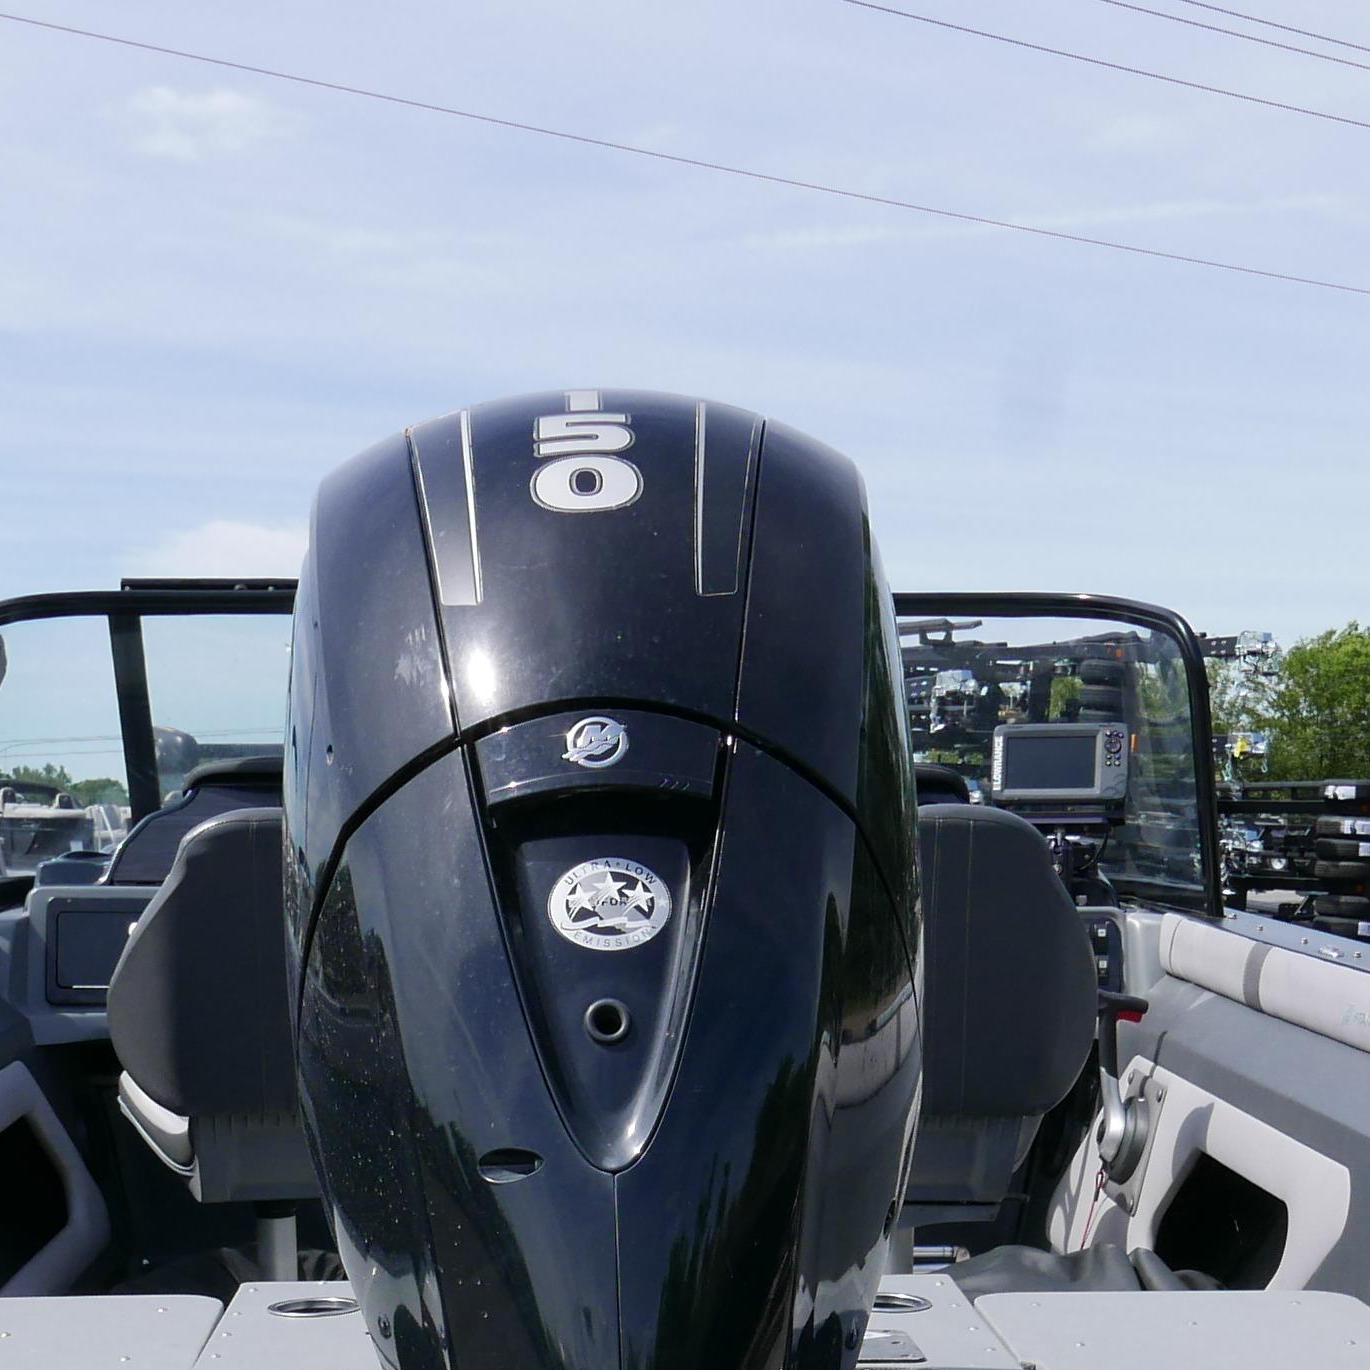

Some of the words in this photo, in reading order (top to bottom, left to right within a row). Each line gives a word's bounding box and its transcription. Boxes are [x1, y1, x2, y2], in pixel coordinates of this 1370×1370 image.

[530, 390, 644, 513] 150
[565, 860, 611, 885] ULTRA
[625, 863, 657, 885] LOW
